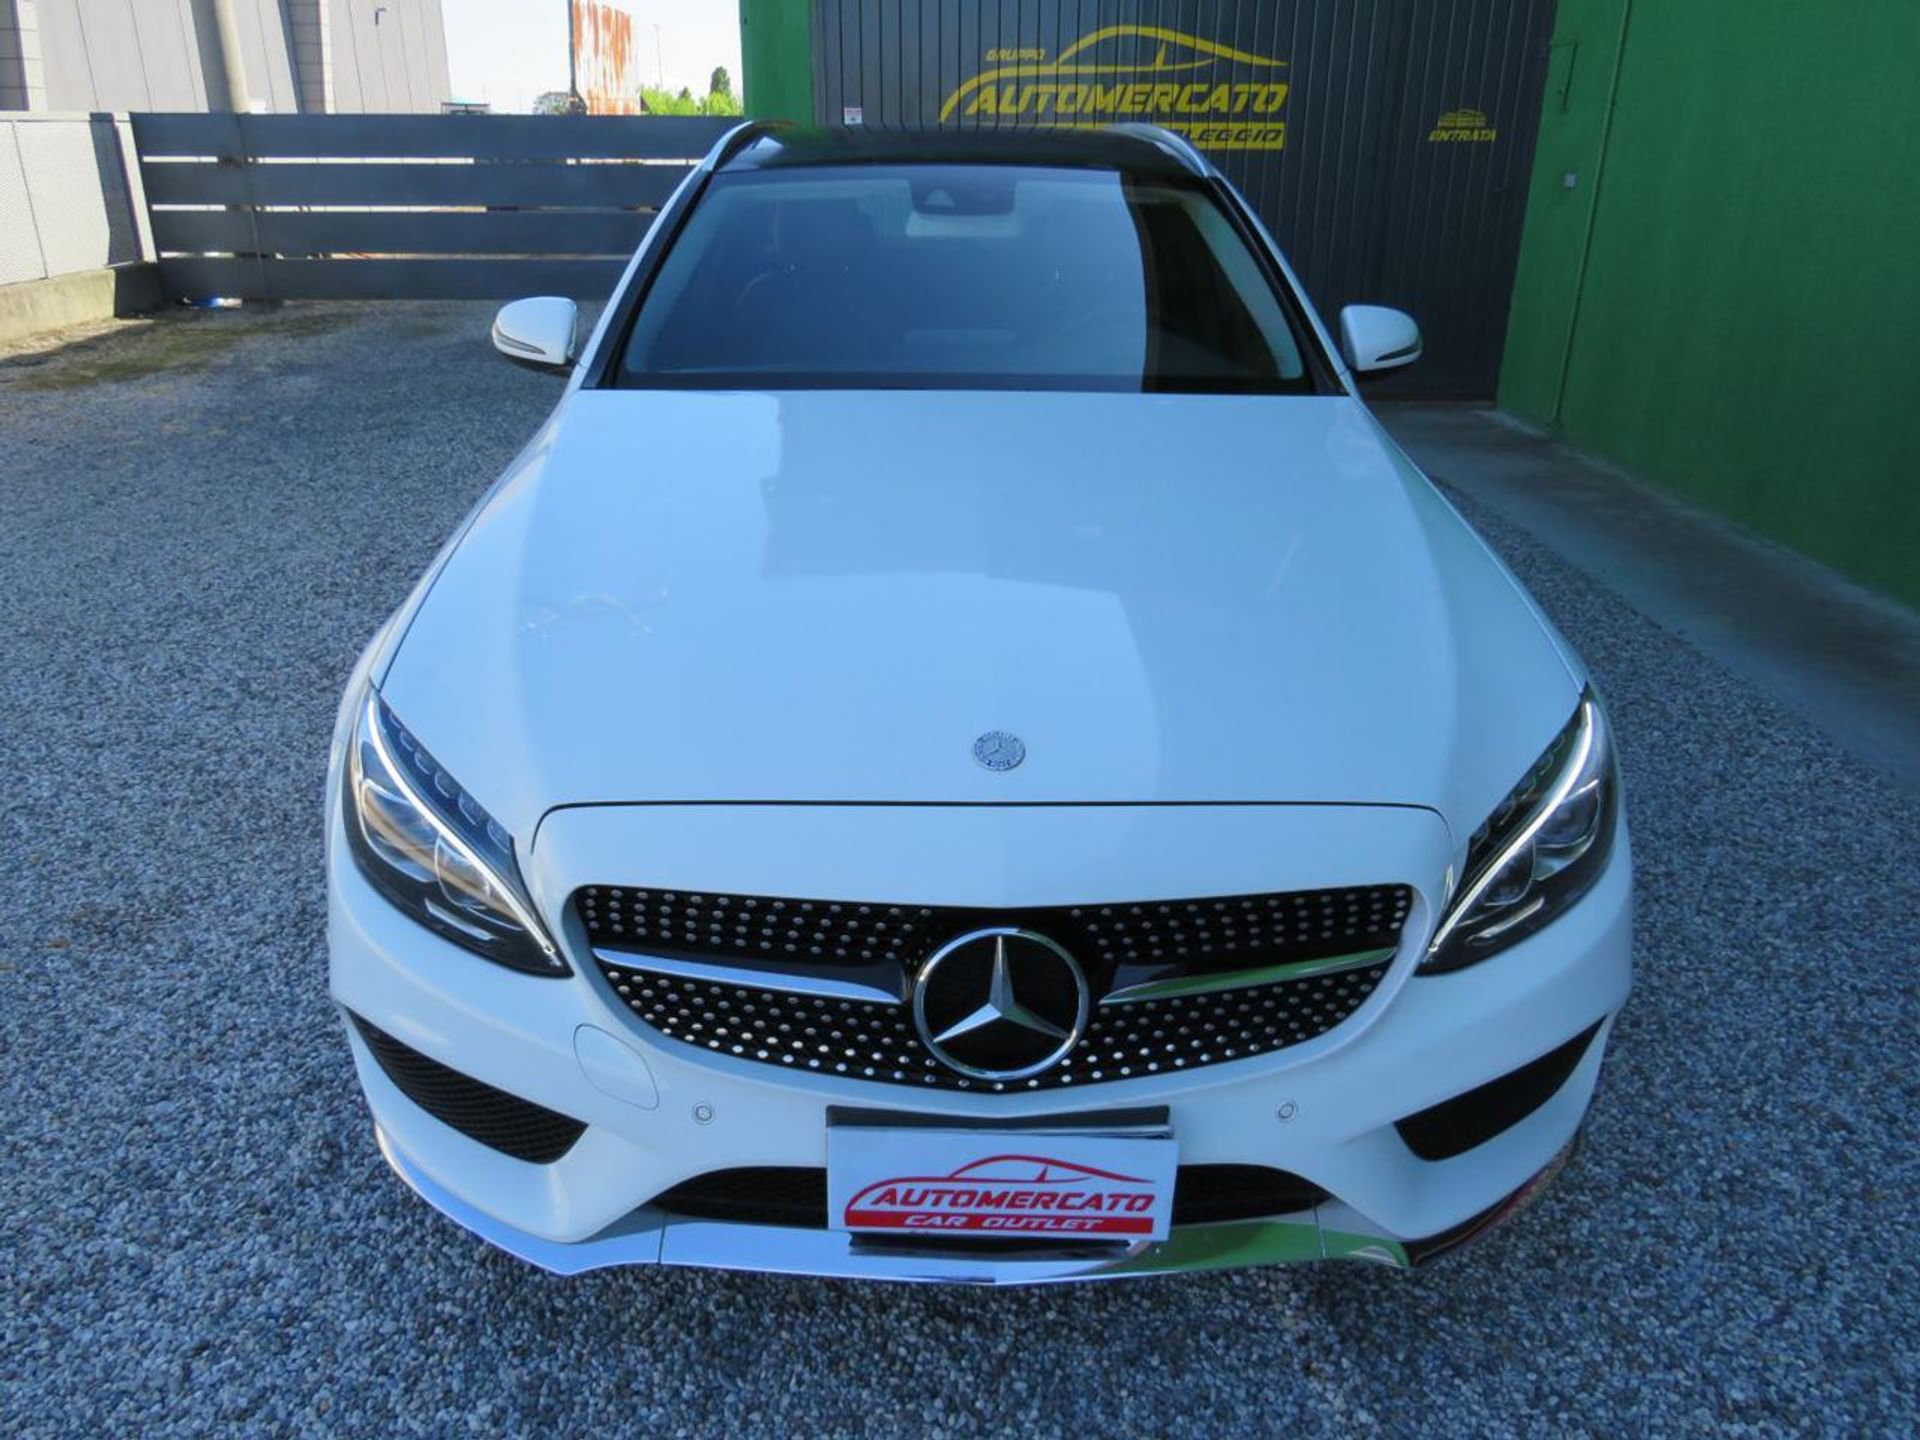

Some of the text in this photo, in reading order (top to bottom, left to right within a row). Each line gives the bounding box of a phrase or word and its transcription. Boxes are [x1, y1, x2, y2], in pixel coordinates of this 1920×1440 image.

[985, 48, 1046, 61] GRUPPO
[965, 83, 1288, 115] AUTOMERCATO
[1428, 129, 1497, 142] ENTRATA
[870, 1187, 1155, 1212] AUTOMERCATO
[904, 1214, 1104, 1230] CAR OUTLET
